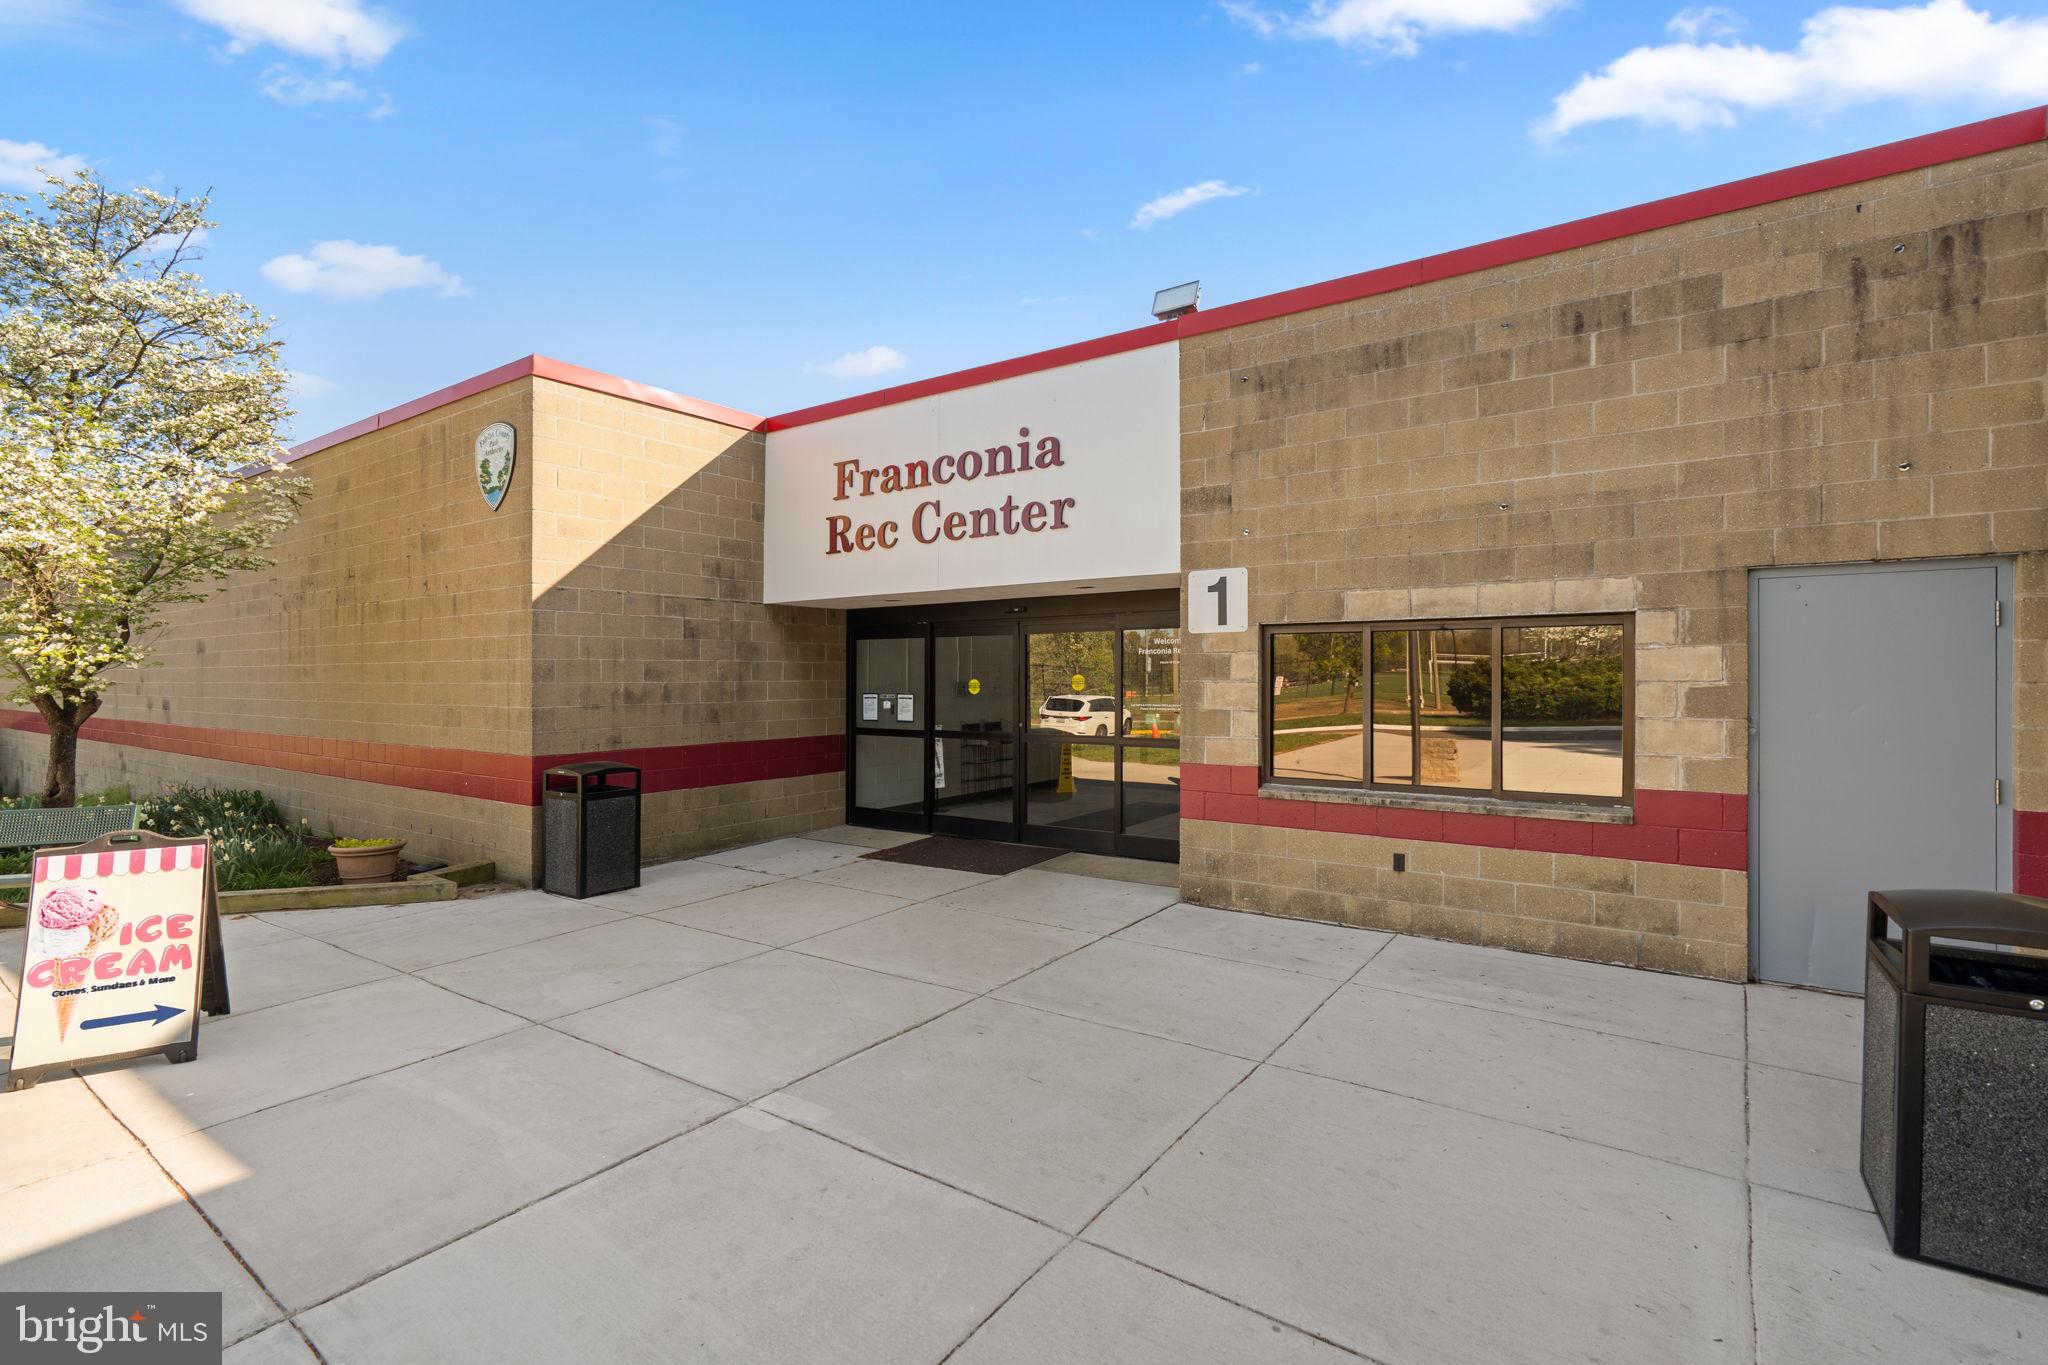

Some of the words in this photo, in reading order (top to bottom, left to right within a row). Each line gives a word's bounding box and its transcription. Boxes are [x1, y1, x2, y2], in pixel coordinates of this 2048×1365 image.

[833, 427, 1065, 501] Franconia
[826, 515, 898, 555] Rec
[911, 495, 1075, 545] Center
[1207, 576, 1227, 626] 1
[1138, 647, 1172, 655] Franconia
[119, 913, 195, 946] ICE
[26, 943, 193, 989] CREAM
[90, 980, 138, 993] Sundaes
[148, 975, 176, 985] More
